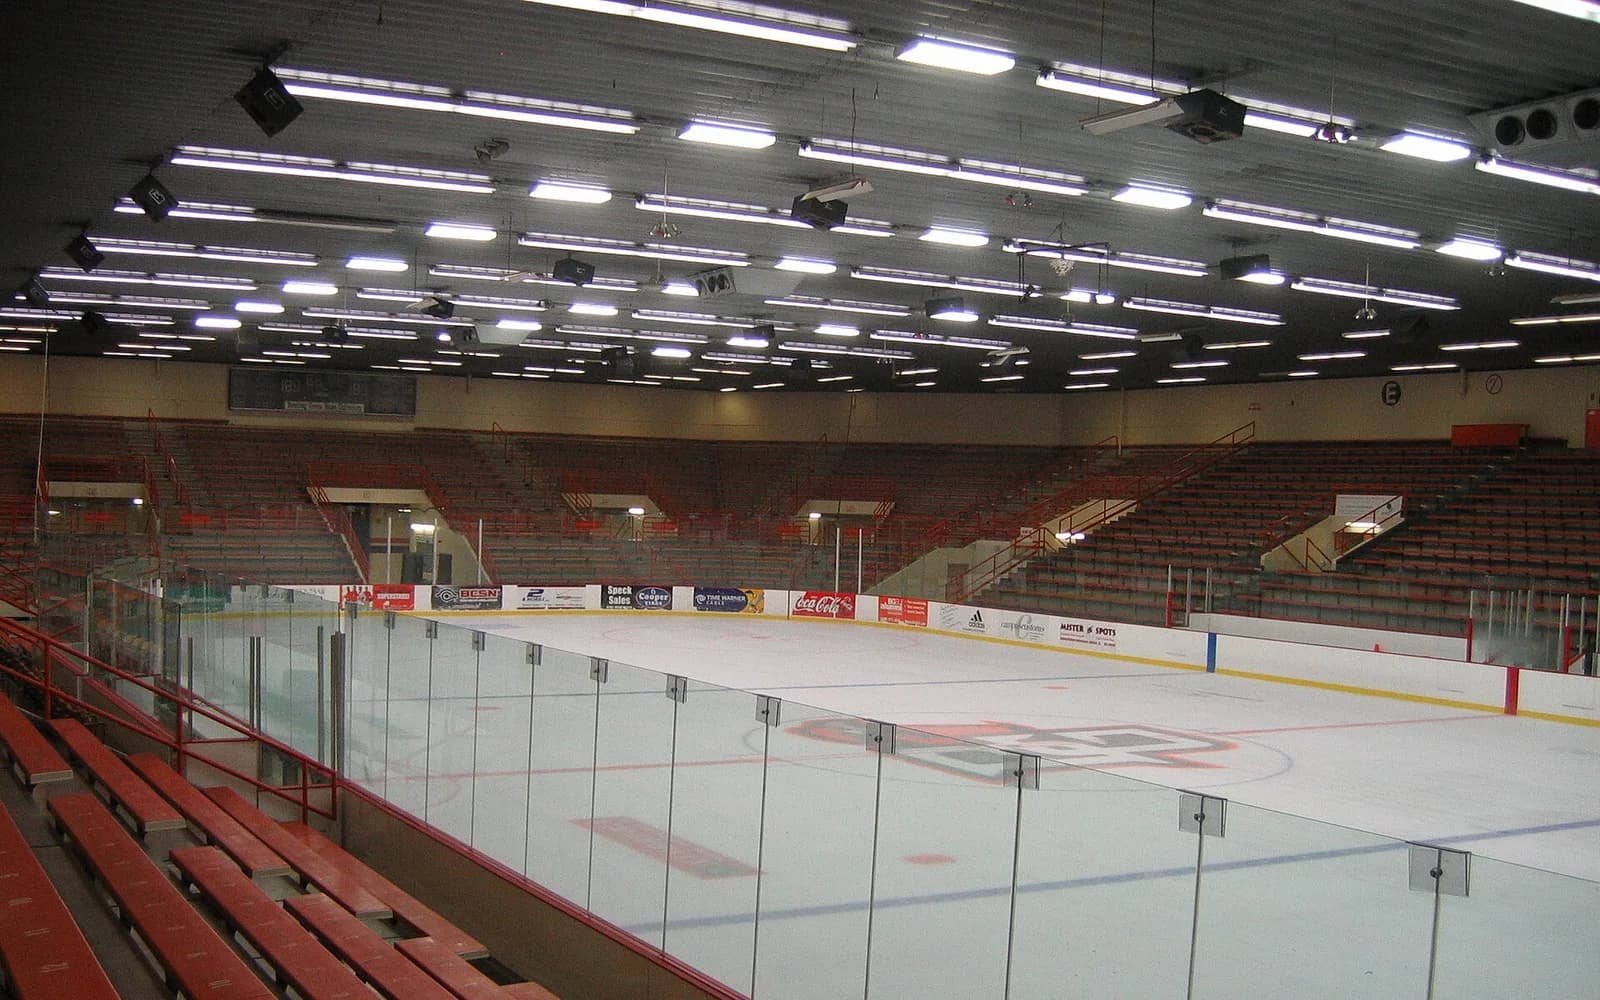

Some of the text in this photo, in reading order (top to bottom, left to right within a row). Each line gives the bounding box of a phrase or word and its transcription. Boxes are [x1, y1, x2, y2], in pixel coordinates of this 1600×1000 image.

[460, 589, 497, 598] BCSN
[608, 586, 632, 595] Speck
[609, 595, 631, 605] Sales
[639, 593, 668, 601] Cooper
[968, 621, 985, 629] adidas
[1060, 623, 1084, 633] MISTER
[1095, 626, 1116, 636] SPOTS
